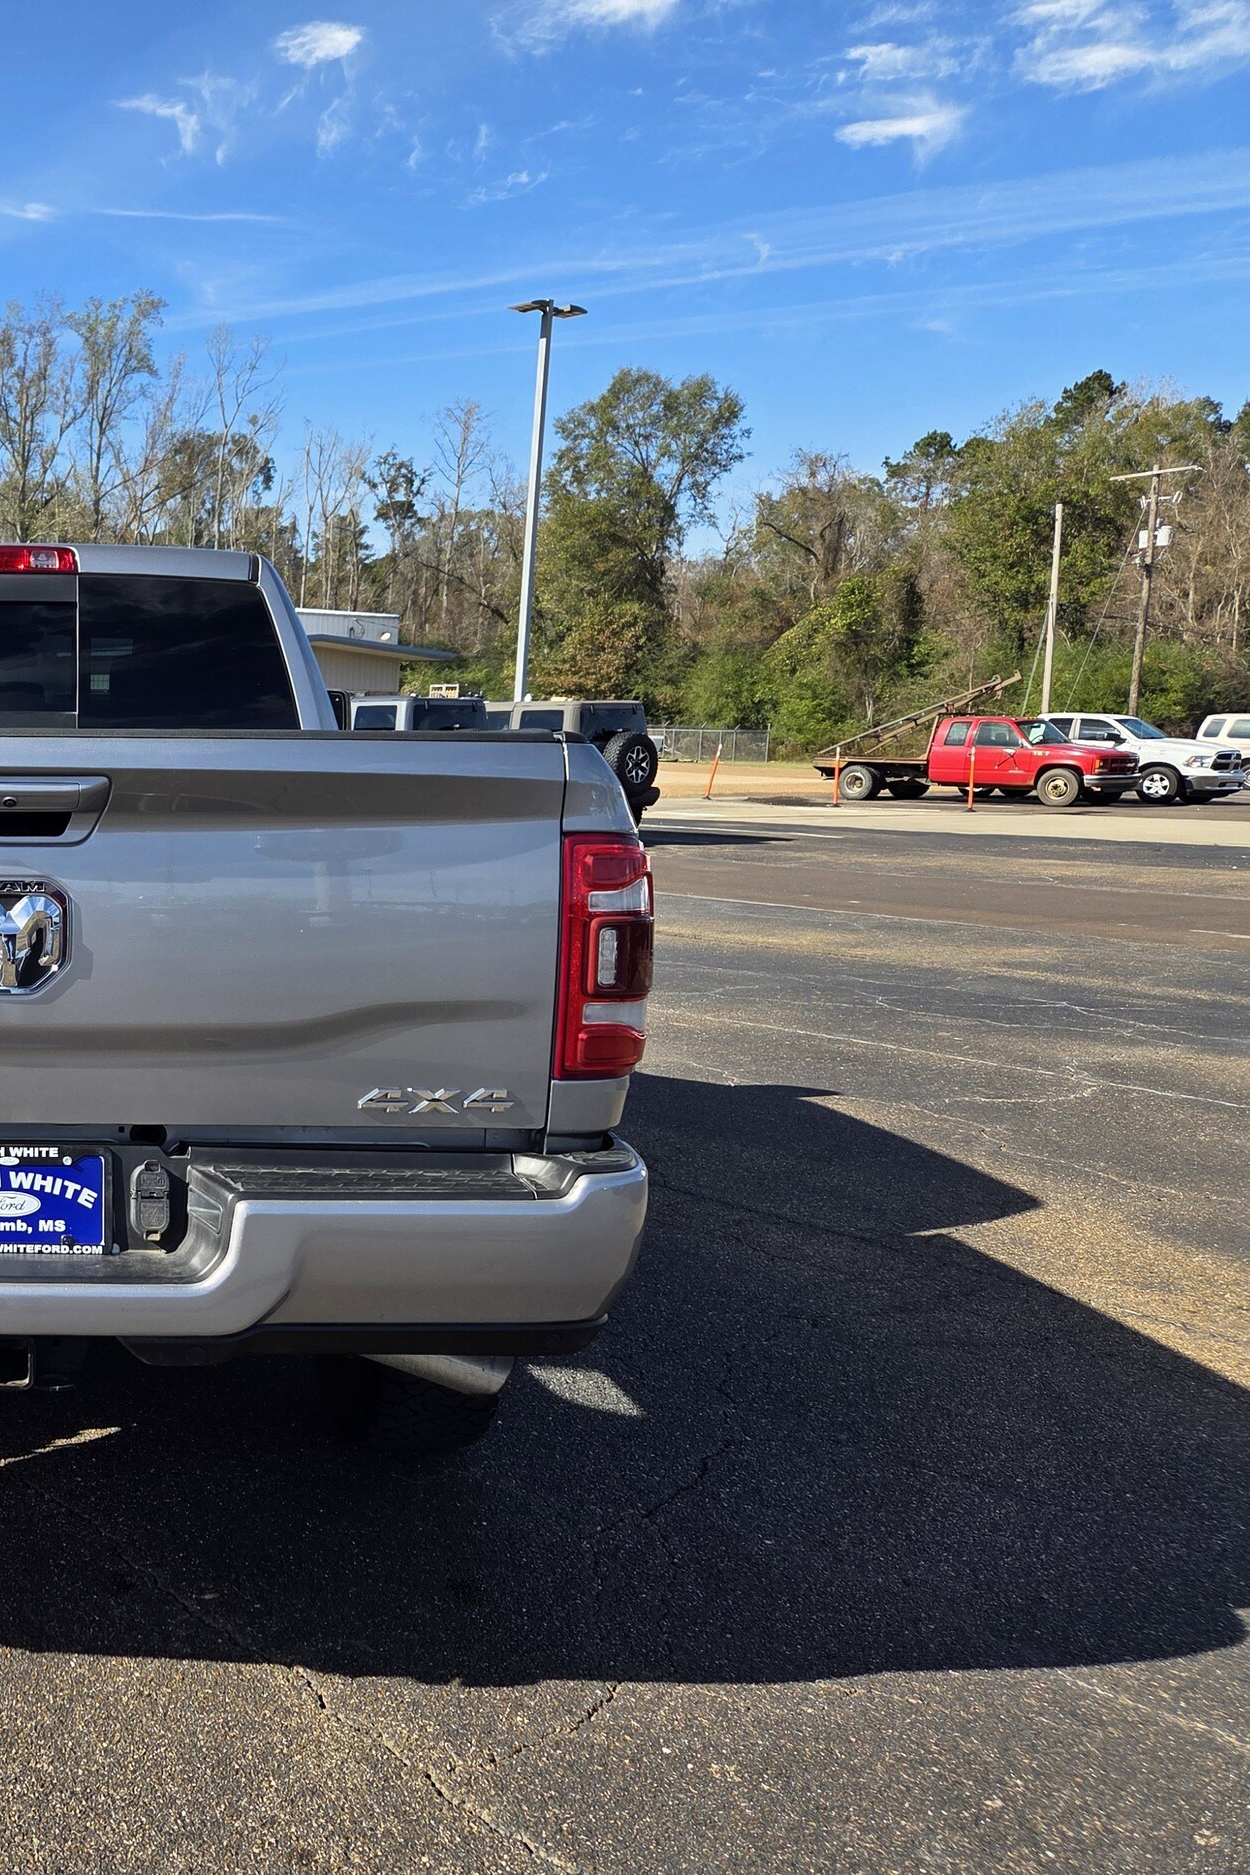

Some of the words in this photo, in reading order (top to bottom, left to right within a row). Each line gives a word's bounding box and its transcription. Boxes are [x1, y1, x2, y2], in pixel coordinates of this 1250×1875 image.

[9, 1146, 59, 1158] WHITE
[9, 1171, 98, 1209] WHITE
[38, 1219, 66, 1232] MS
